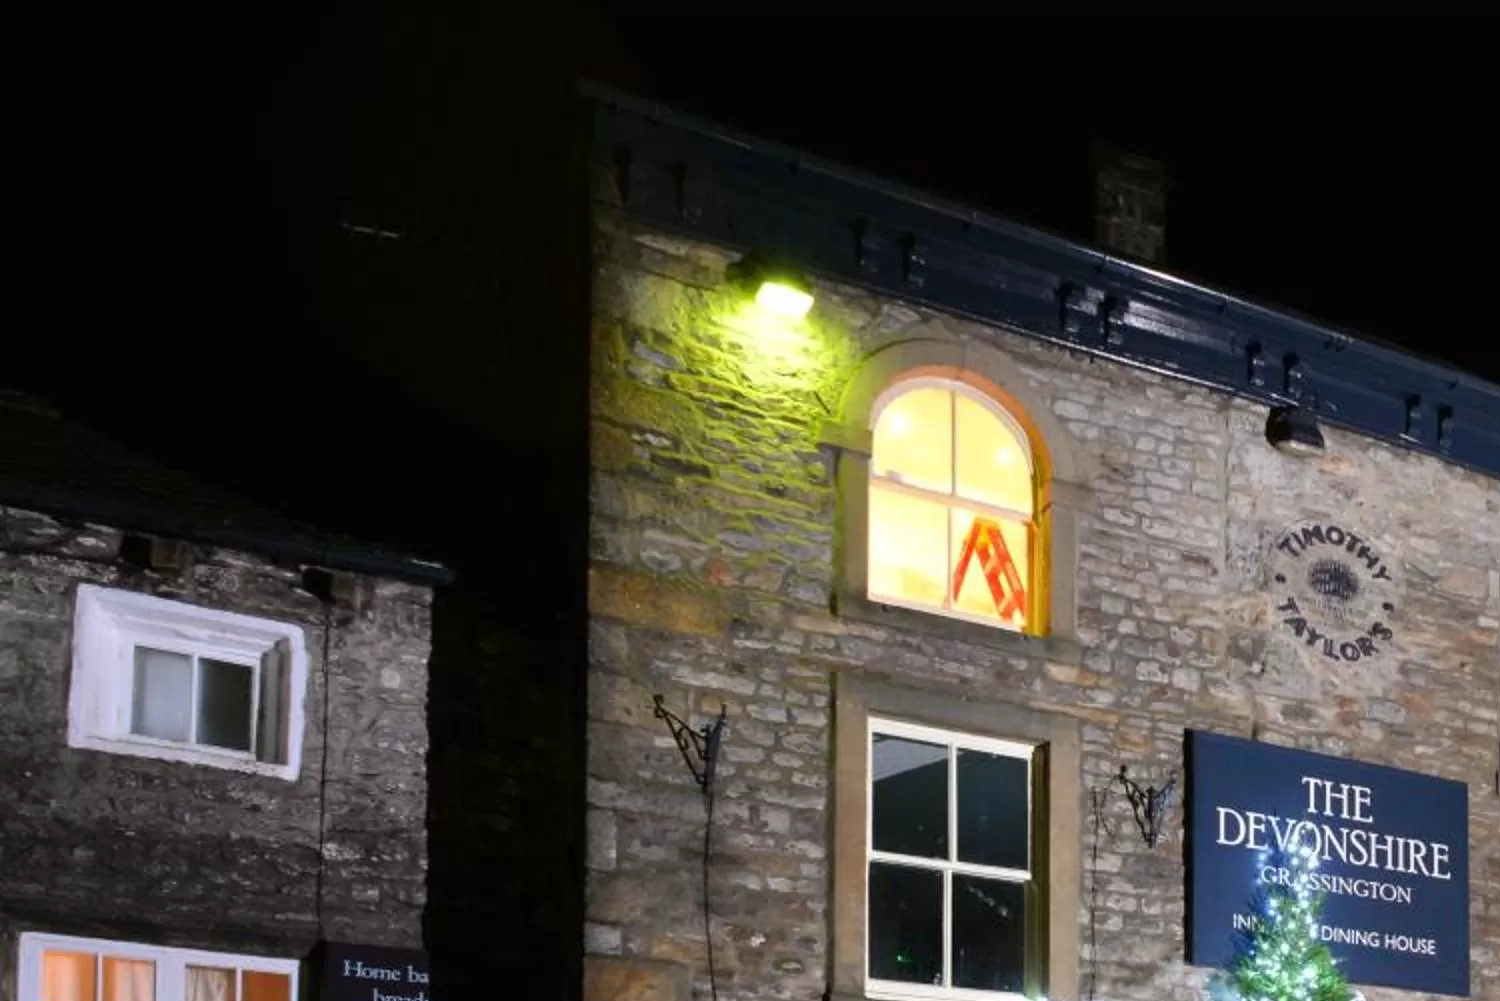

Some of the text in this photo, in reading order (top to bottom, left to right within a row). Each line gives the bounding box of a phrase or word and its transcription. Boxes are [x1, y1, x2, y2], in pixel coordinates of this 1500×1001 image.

[1278, 525, 1392, 581] TIMOTHY
[1301, 776, 1373, 823] THE
[1216, 806, 1451, 880] DEVONSHIRE
[1260, 865, 1412, 905] GRSSINGTON
[1321, 925, 1380, 948] DINING
[1385, 934, 1436, 955] HOUSE
[343, 959, 401, 982] Home
